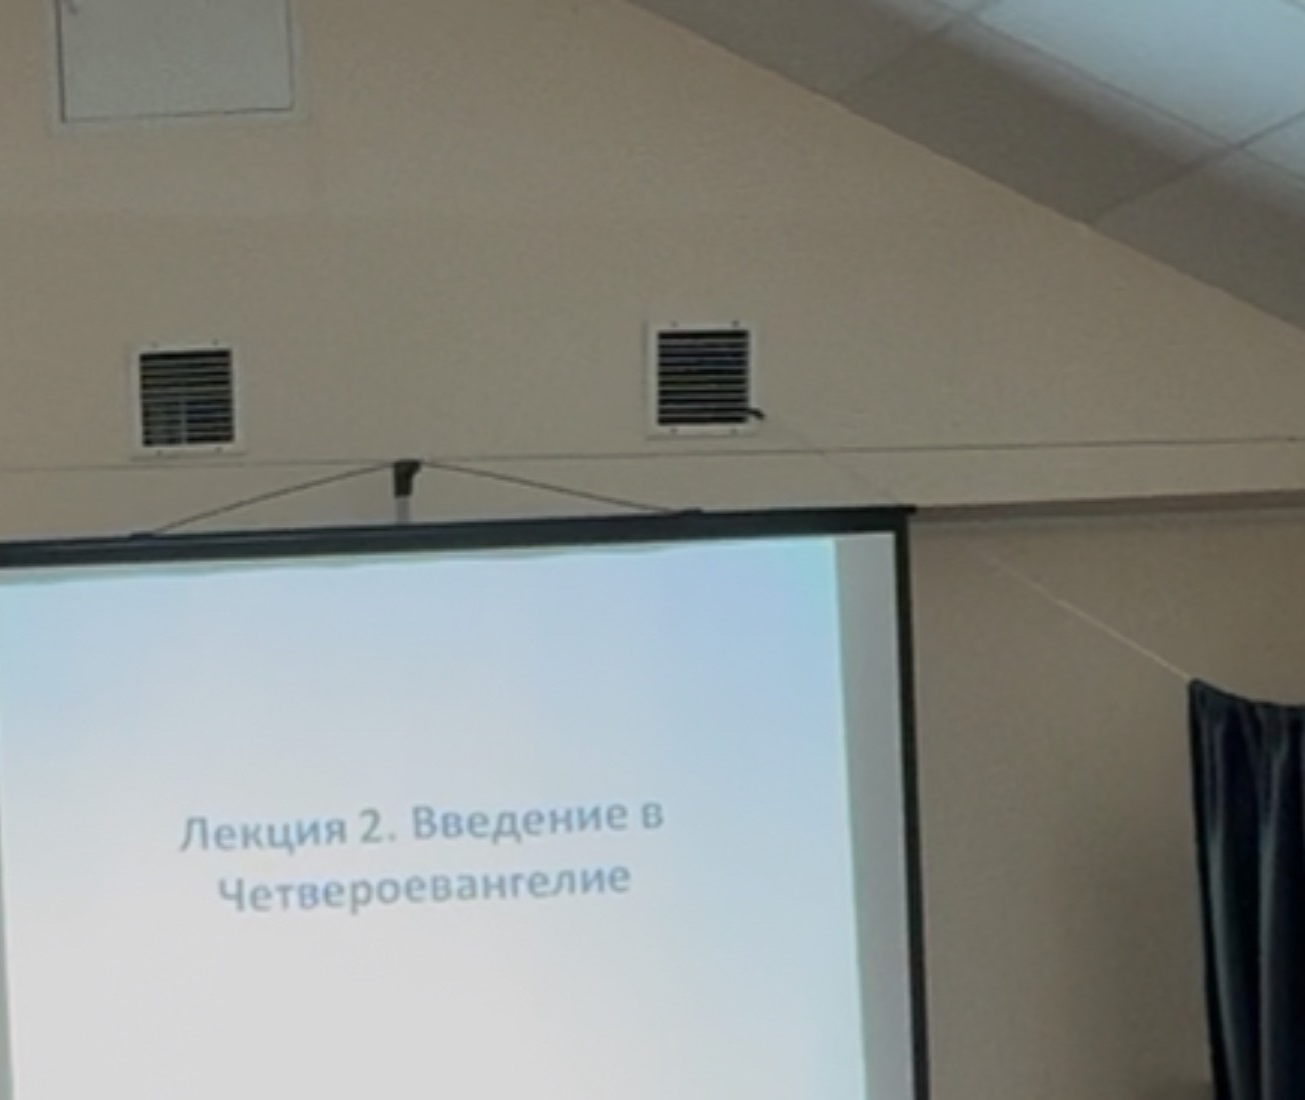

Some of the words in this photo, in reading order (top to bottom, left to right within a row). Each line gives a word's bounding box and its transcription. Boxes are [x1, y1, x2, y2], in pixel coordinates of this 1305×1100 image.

[179, 814, 347, 856] Лекция
[358, 808, 397, 845] 2.
[410, 802, 630, 845] Введение
[641, 801, 665, 830] в
[217, 864, 632, 915] Четвероевангелие
